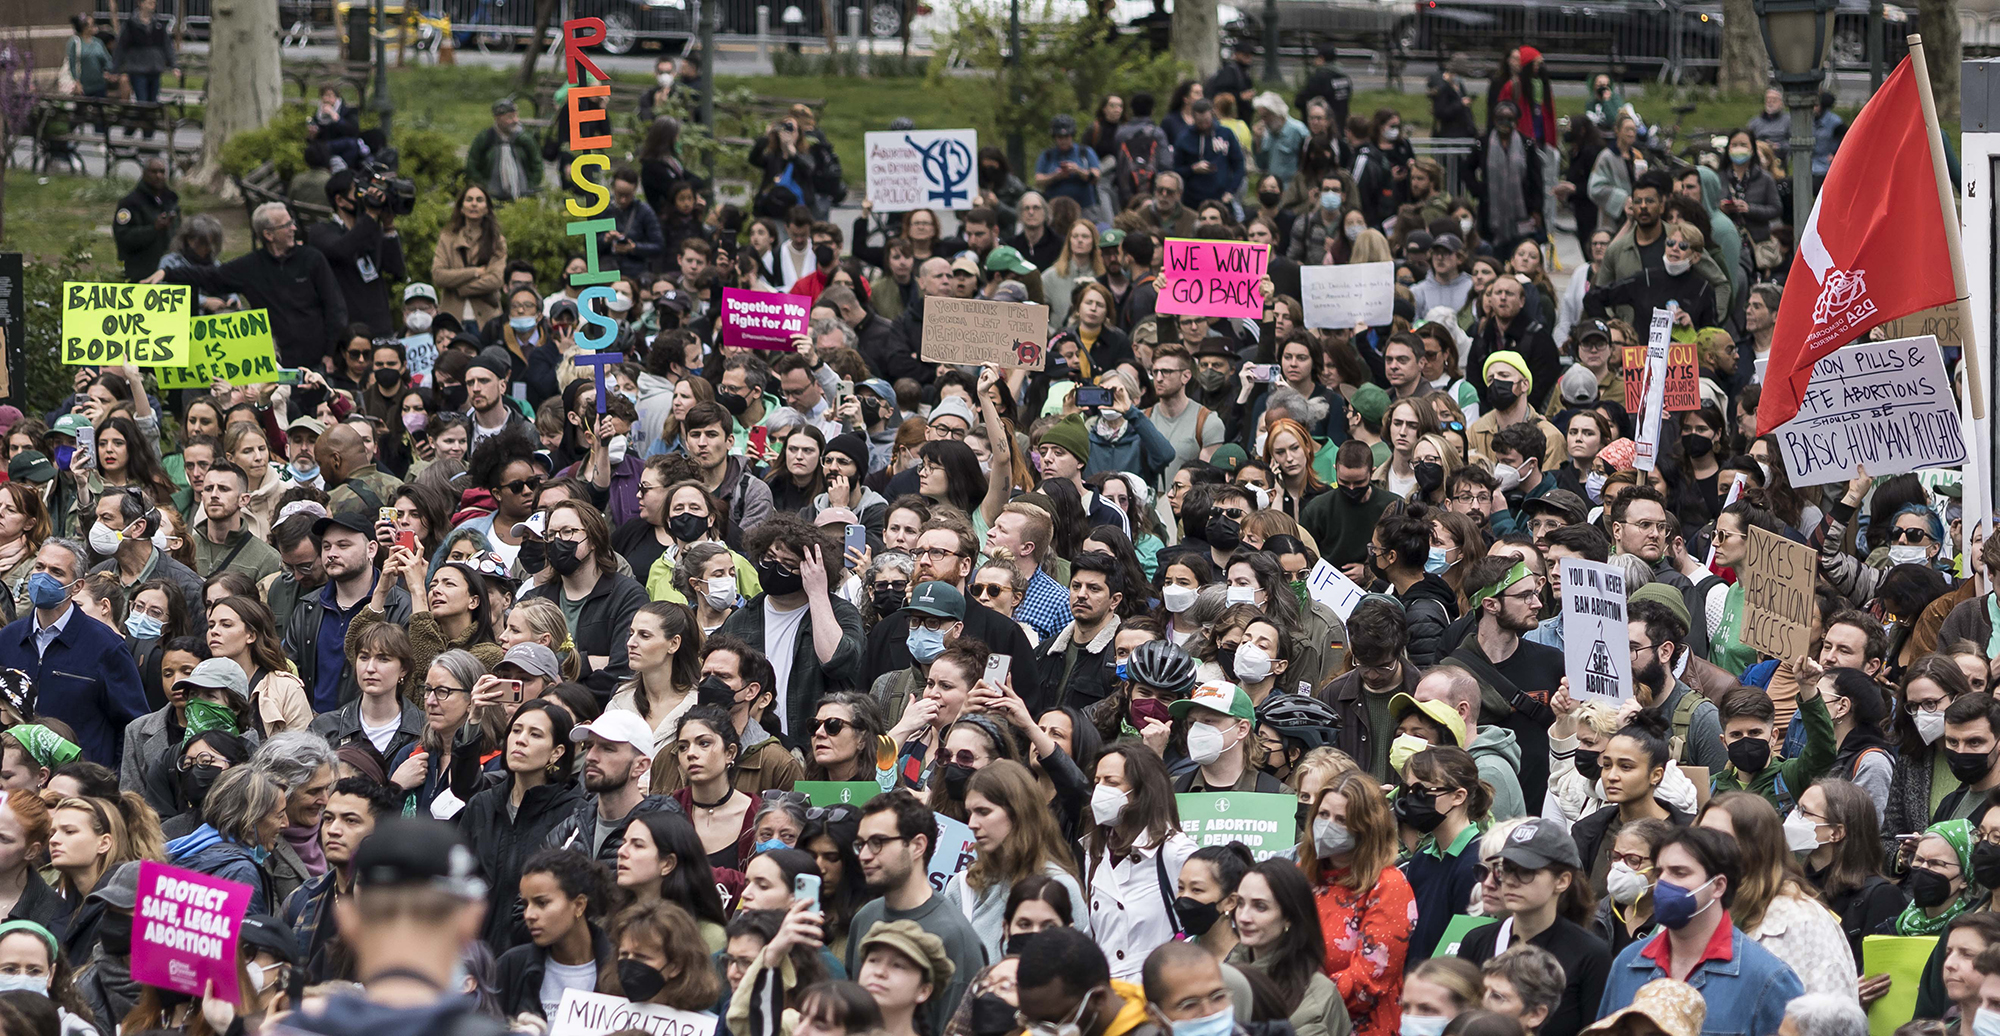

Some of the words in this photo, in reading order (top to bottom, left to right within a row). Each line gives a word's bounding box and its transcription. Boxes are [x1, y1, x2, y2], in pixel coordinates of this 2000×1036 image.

[564, 17, 623, 413] RESIST
[1170, 245, 1201, 271] WE
[1213, 246, 1266, 275] WON'T
[68, 286, 135, 310] BANS
[144, 288, 186, 312] OFF
[1172, 278, 1204, 304] GO
[1209, 278, 1260, 308] BACK
[727, 298, 782, 315] Together
[783, 303, 806, 317] We
[935, 301, 959, 313] YOU
[961, 301, 998, 315] THINK
[102, 313, 151, 335] OUR
[190, 313, 269, 341] ORTION
[729, 313, 760, 328] Fight
[761, 315, 781, 329] for
[781, 319, 801, 331] All
[928, 314, 967, 326] GONNA
[974, 316, 1000, 329] LET
[1008, 320, 1034, 334] THE
[1920, 316, 1960, 341] ABOR
[925, 325, 1010, 346] DEMOCRATIC
[67, 336, 175, 362] BODIES
[205, 342, 226, 362] IS
[408, 342, 434, 361] ODY
[924, 343, 960, 360] PARTY
[1625, 347, 1648, 368] FUC
[1854, 349, 1904, 372] PILLS
[1908, 346, 1926, 367] &
[1625, 368, 1643, 382] MY
[1680, 365, 1693, 379] IS
[1664, 393, 1695, 407] ECISION
[1798, 389, 1834, 414] FE
[1843, 377, 1936, 407] ABORTIONS
[1810, 412, 1860, 428] SHOULD
[1871, 403, 1895, 418] BE
[1785, 431, 1848, 476] BASIC
[1844, 416, 1913, 465] HUMAN
[1909, 409, 1967, 461] RIGHTS
[1748, 529, 1794, 580] DYKES
[1803, 551, 1812, 588] 4
[1313, 565, 1341, 591] IF
[1568, 567, 1584, 587] YOU
[1587, 568, 1598, 588] WI
[1605, 573, 1623, 595] NEVER
[1574, 594, 1590, 615] BAN
[1591, 596, 1622, 622] ABORTION
[1747, 571, 1809, 628] ABORTION
[1745, 610, 1794, 660] ACCESS
[1593, 652, 1609, 674] SAFE
[1586, 674, 1620, 699] ABORTION
[1179, 819, 1200, 832] REE
[1205, 818, 1278, 833] ABORTION
[1203, 833, 1264, 847] DEMAND
[155, 875, 229, 912] PROTECT
[141, 895, 181, 928] SAFE,
[183, 906, 231, 939] LEGAL
[143, 921, 223, 960] ABORTION
[568, 999, 705, 1036] MINORITAR
